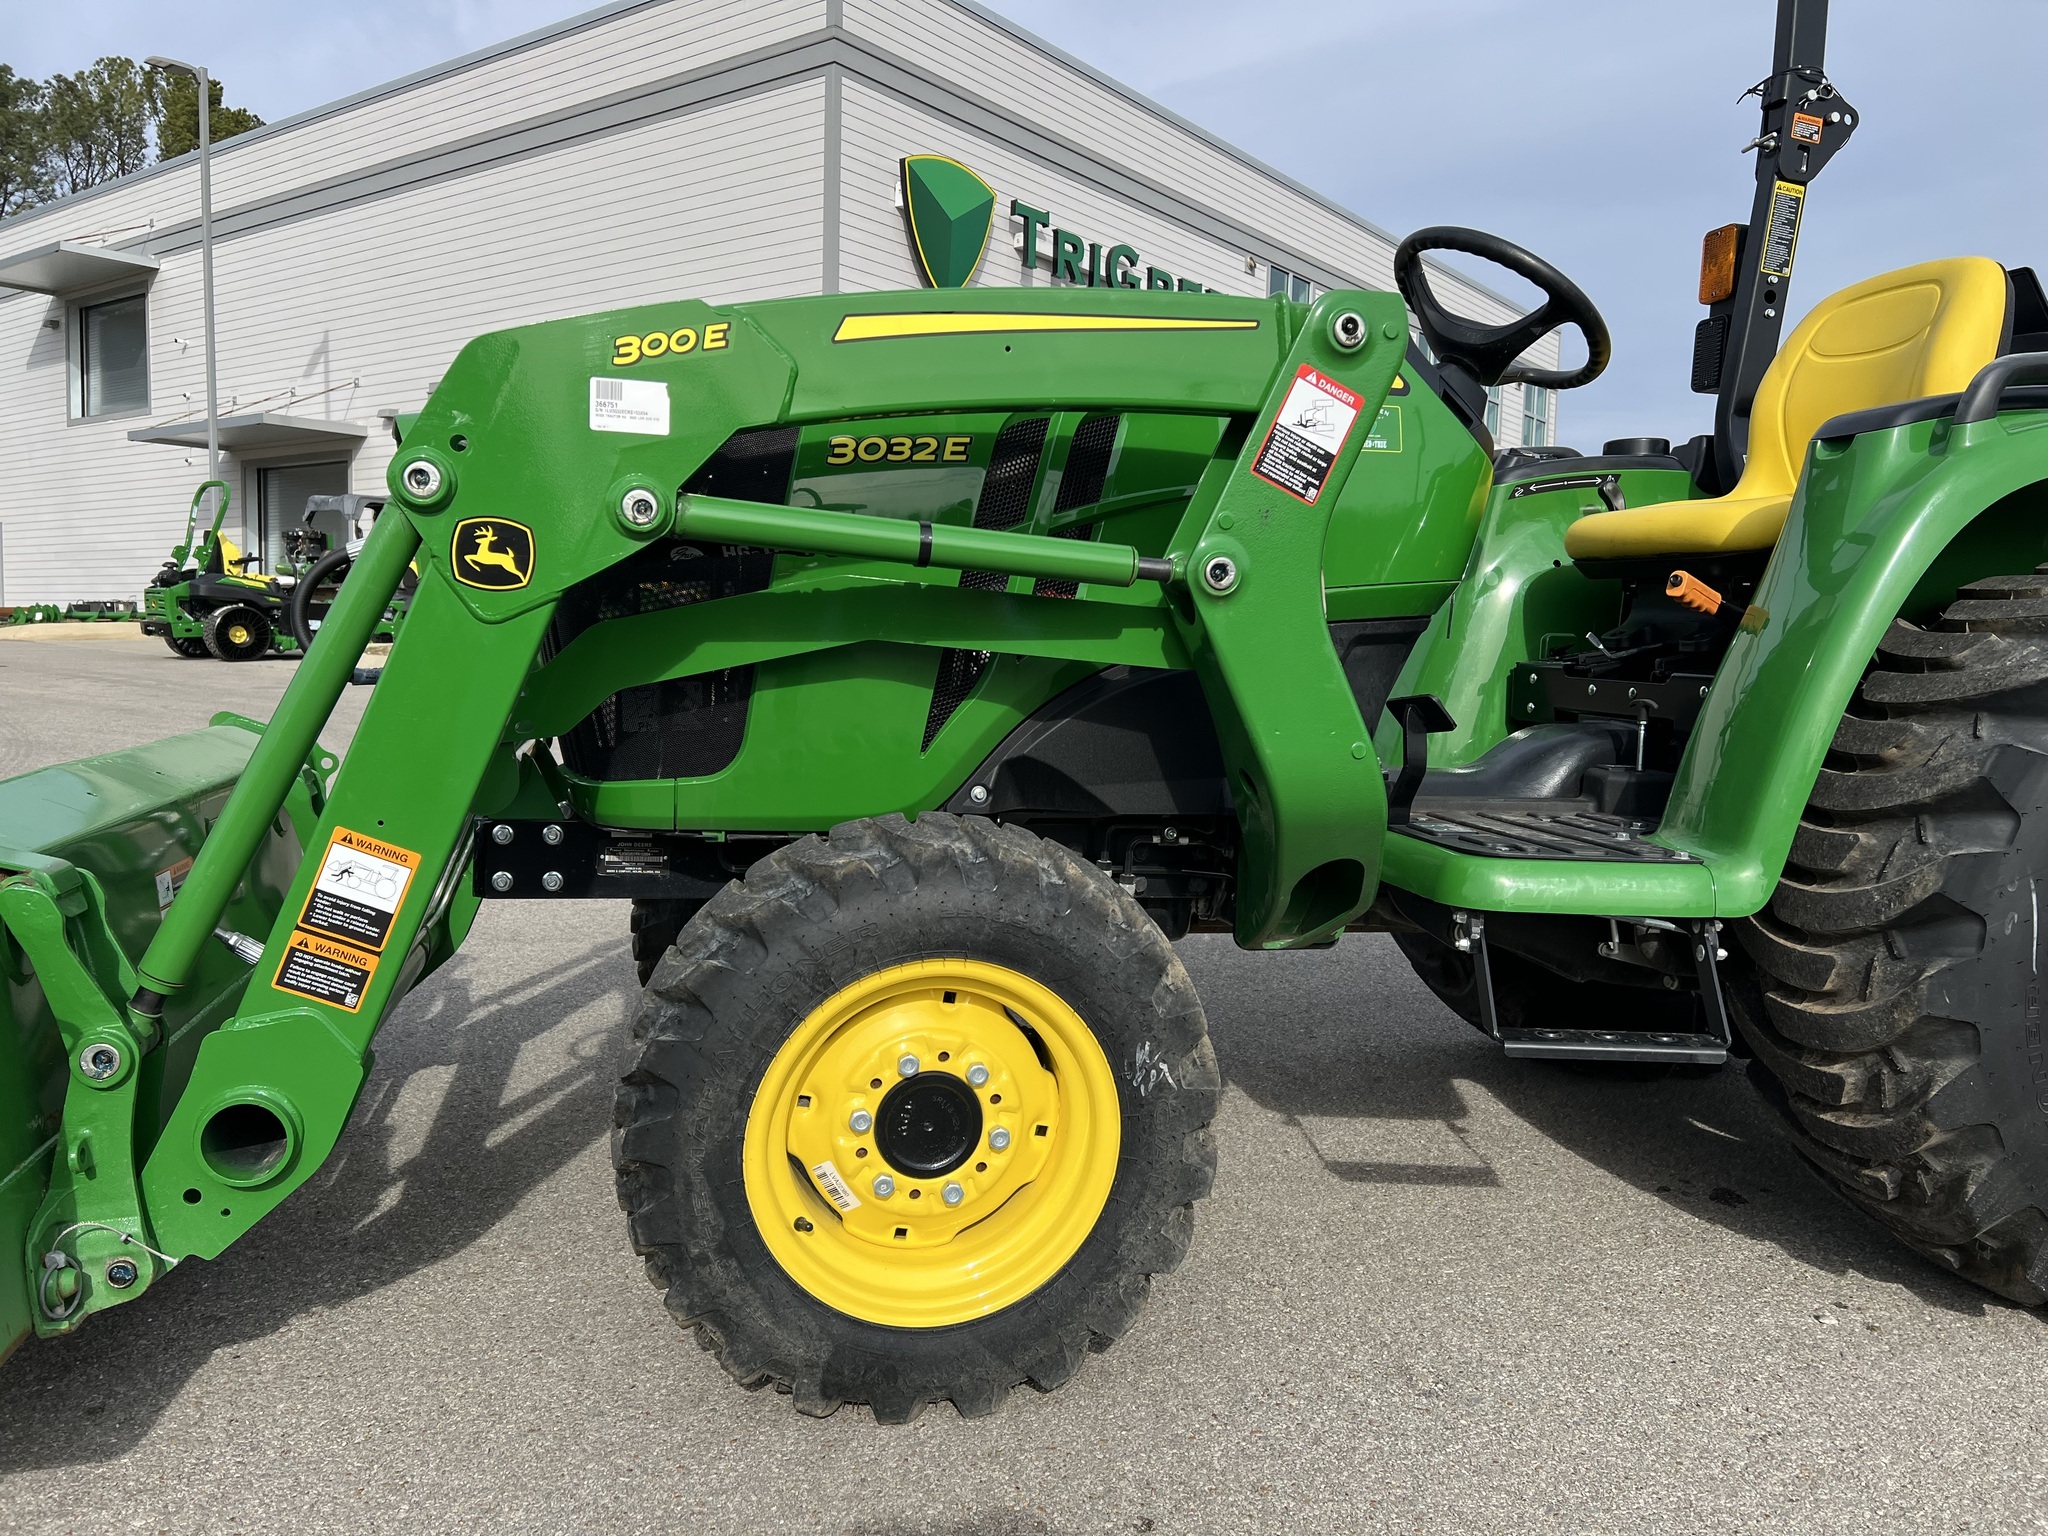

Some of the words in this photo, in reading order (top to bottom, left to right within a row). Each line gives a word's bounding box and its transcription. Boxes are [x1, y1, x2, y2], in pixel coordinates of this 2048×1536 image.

[1782, 185, 1803, 195] CAUTION
[1010, 199, 1229, 294] TRIG
[1319, 379, 1355, 405] DANGER
[826, 435, 973, 465] 3032E
[356, 838, 409, 863] WARNING
[315, 943, 368, 966] WARNING
